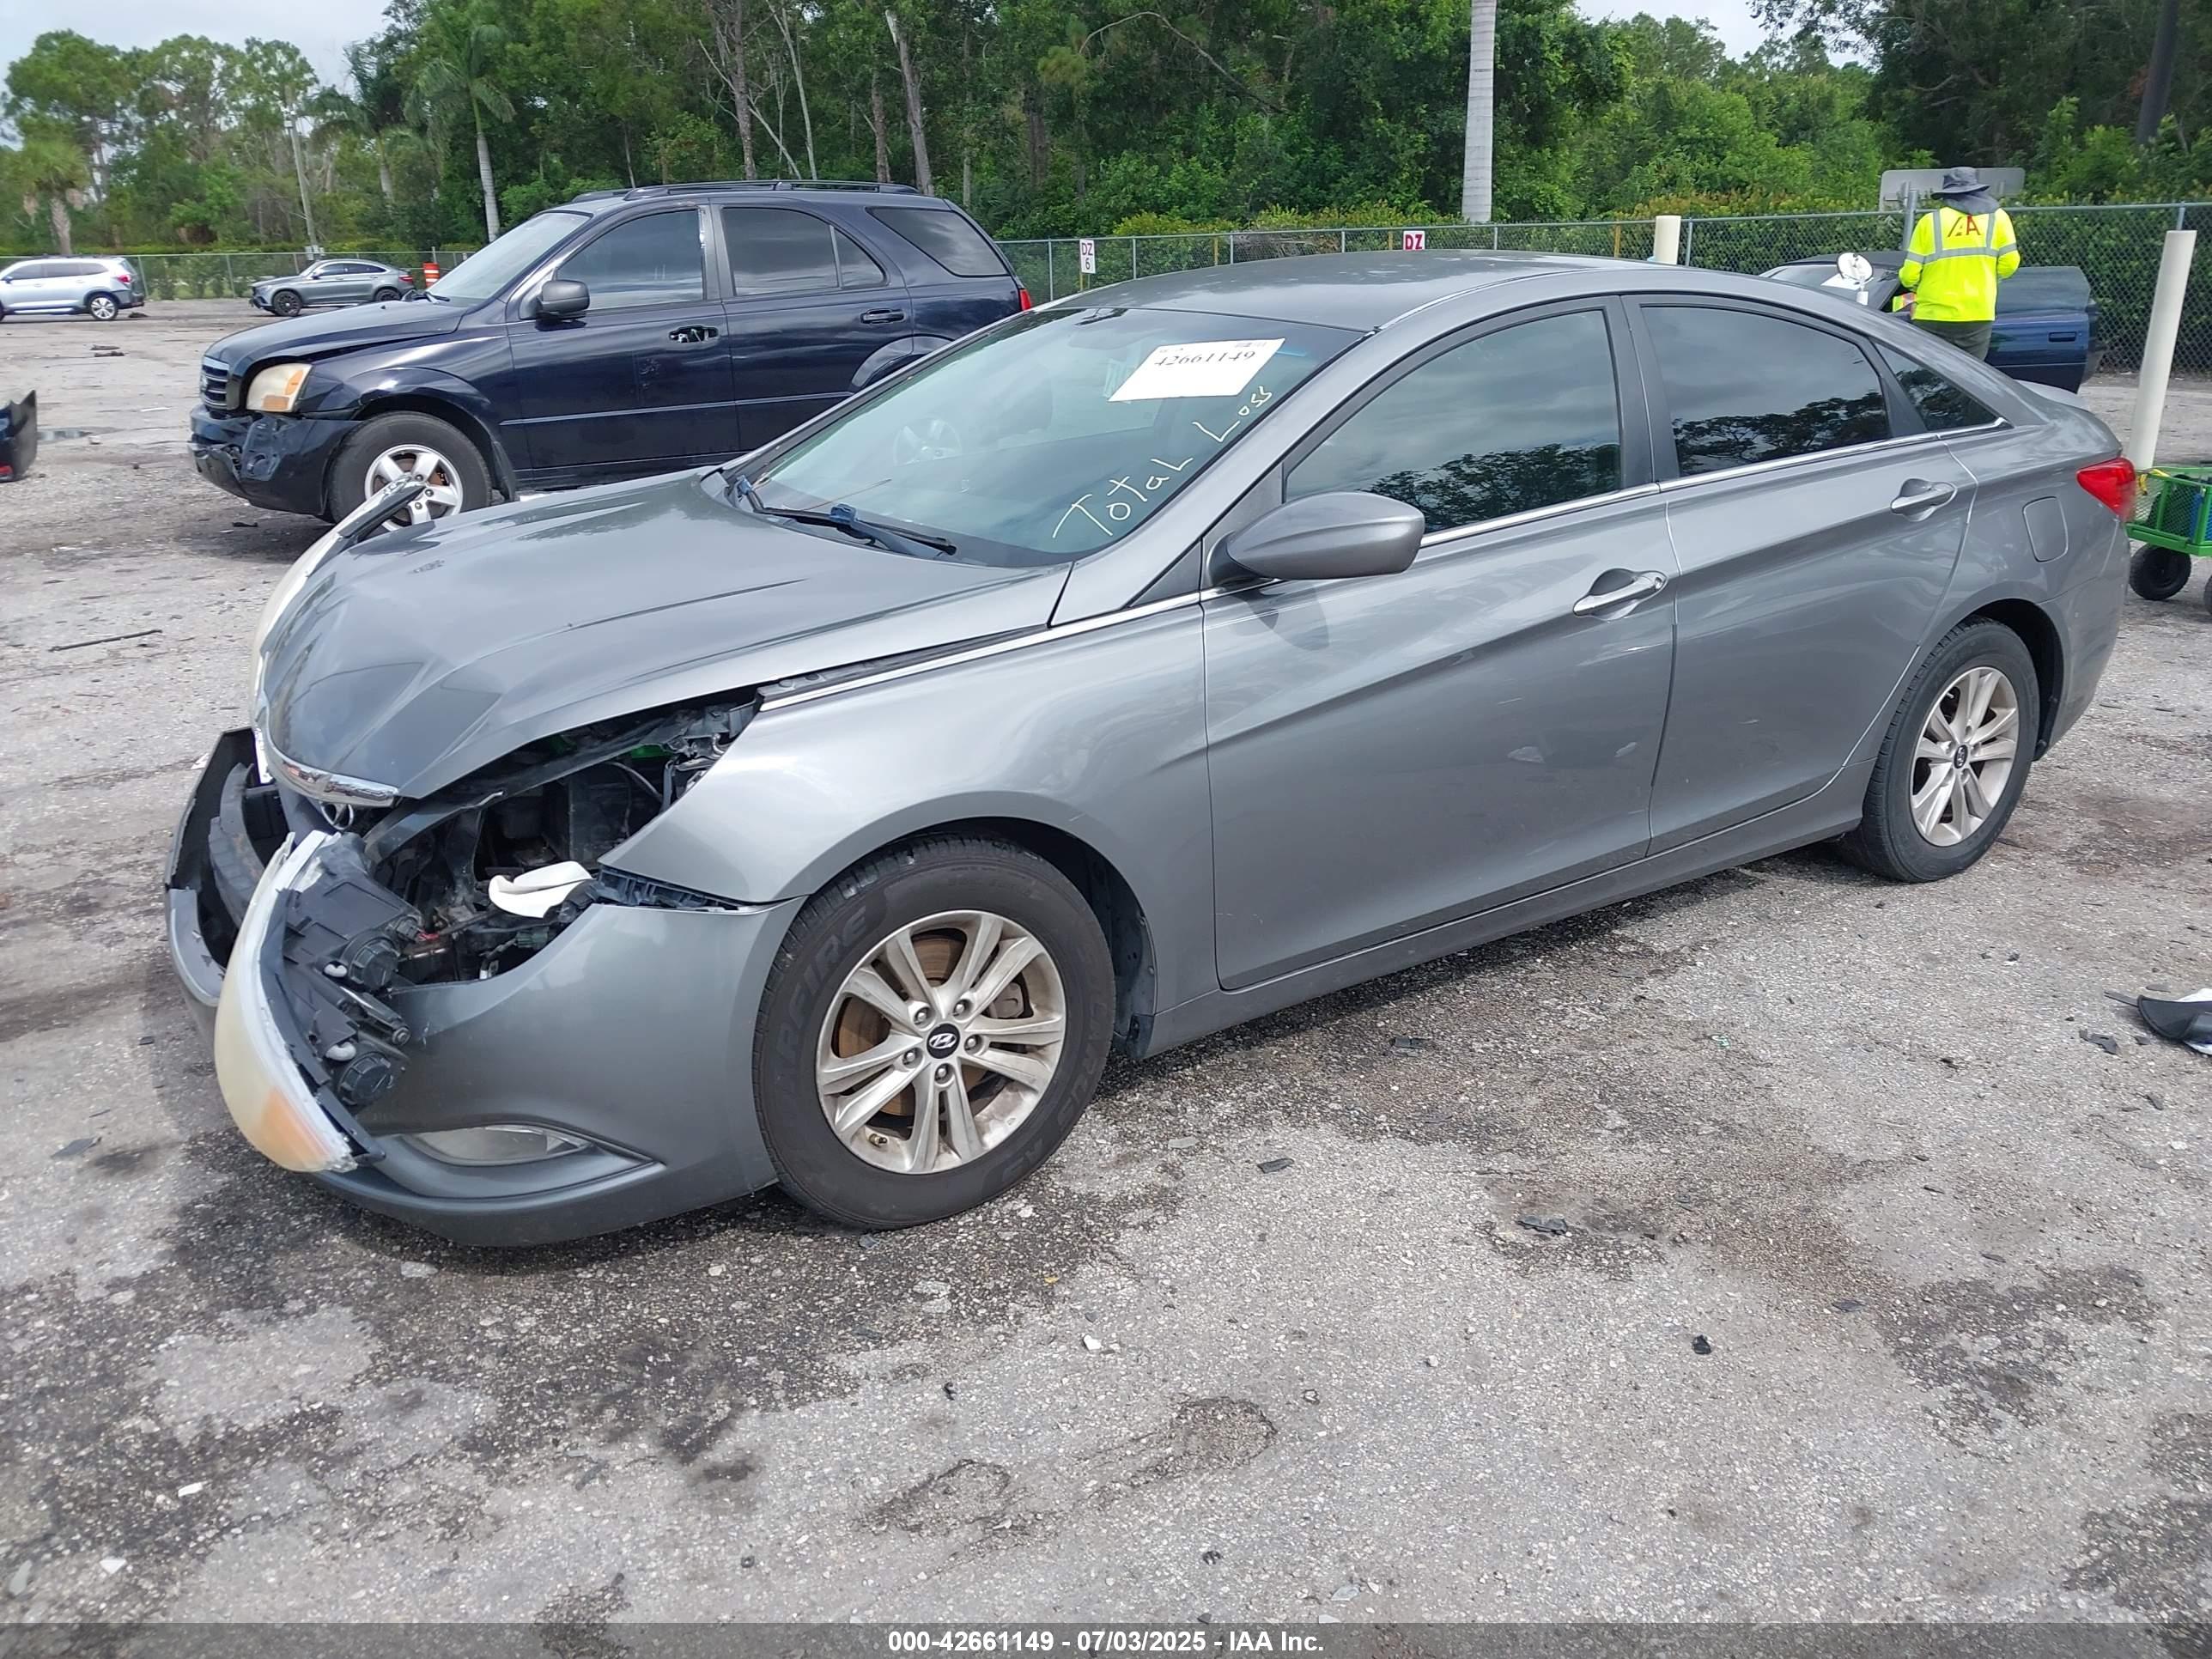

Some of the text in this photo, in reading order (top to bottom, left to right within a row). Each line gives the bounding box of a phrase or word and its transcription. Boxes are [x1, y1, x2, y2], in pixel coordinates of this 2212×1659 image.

[1081, 242, 1093, 256] DZ
[1405, 234, 1423, 251] DZ
[1085, 258, 1091, 270] 6
[1191, 386, 1273, 443] Loss
[775, 902, 869, 1086] RFIRE
